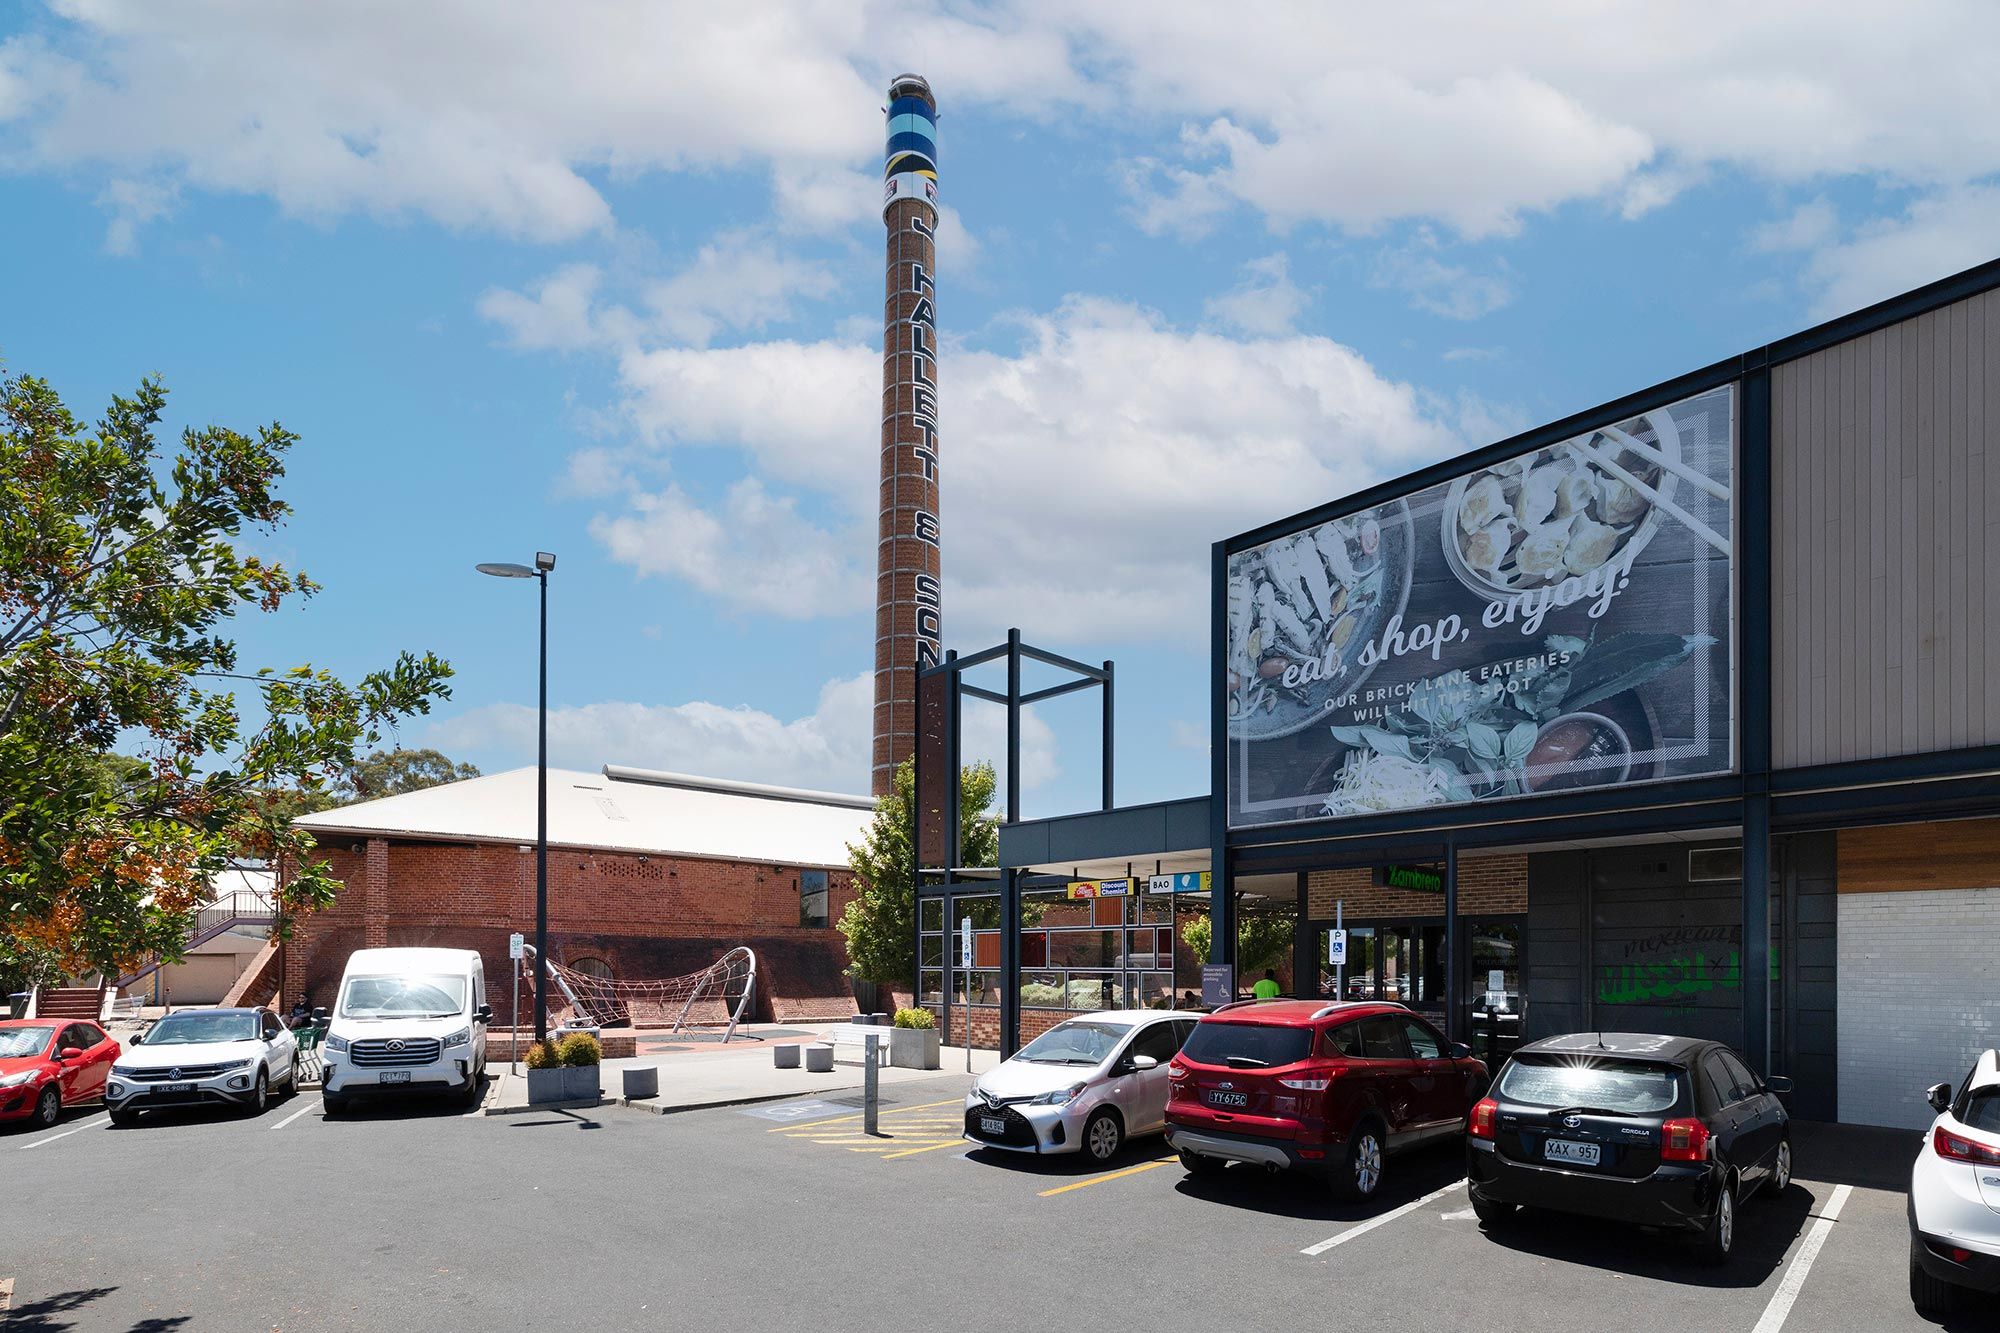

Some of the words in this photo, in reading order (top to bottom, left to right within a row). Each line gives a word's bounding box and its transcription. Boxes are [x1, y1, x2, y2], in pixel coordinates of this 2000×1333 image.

[911, 215, 934, 245] J
[909, 263, 938, 483] HALLETT
[914, 510, 940, 551] &
[1281, 640, 1348, 689] eat,
[1357, 613, 1471, 665] shop,
[1482, 548, 1635, 635] enjoy!
[1324, 693, 1359, 712] OUR
[1366, 681, 1417, 704] BRICK
[1425, 668, 1471, 691] LANE
[1480, 650, 1571, 681] EATERIES
[1353, 704, 1392, 723] WILL
[1400, 696, 1429, 715] HIT
[1438, 687, 1473, 707] THE
[1480, 676, 1533, 700] SPOT
[1101, 880, 1127, 889] Discount
[1101, 887, 1126, 895] Chemist
[1153, 880, 1169, 889] BAO
[1388, 864, 1441, 892] Zambrero
[1335, 931, 1341, 940] P
[1621, 1128, 1650, 1136] COROLLA
[1547, 1141, 1570, 1156] XAX
[1578, 1146, 1598, 1160] 957
